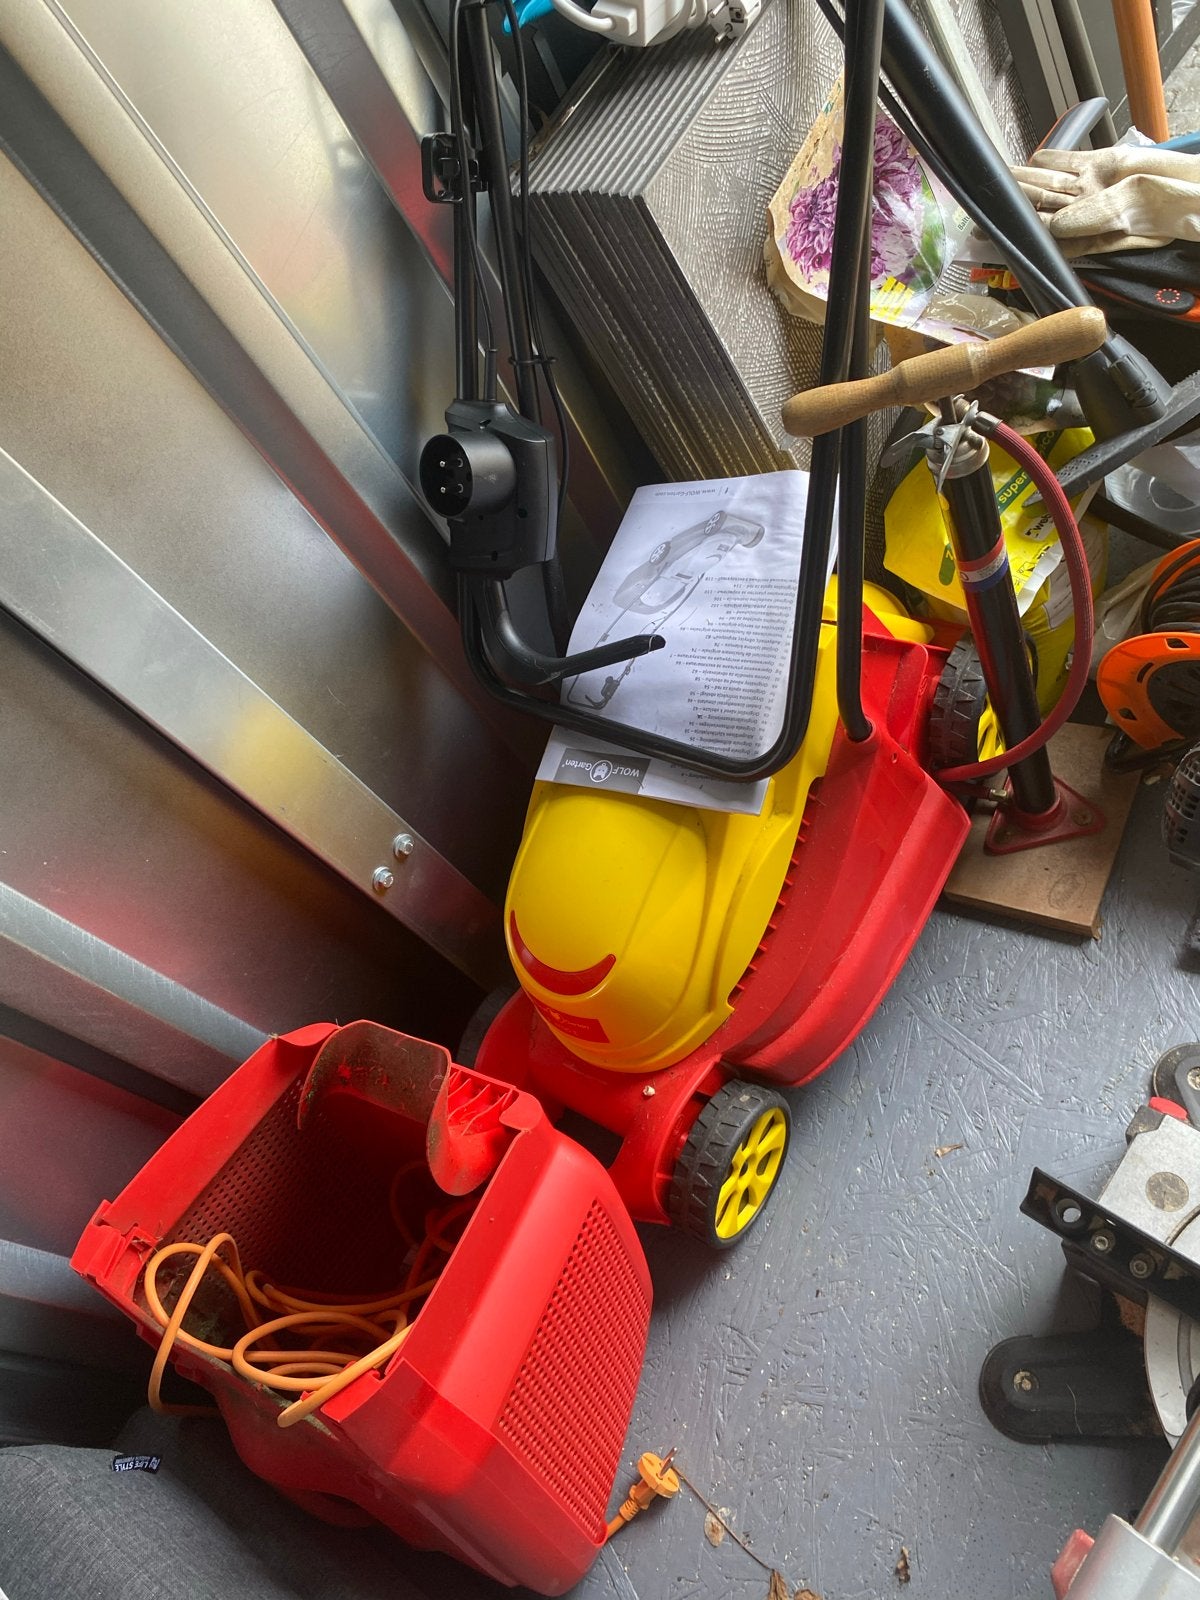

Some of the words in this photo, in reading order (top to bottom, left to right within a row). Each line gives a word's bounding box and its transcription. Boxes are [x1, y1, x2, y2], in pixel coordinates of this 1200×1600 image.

[998, 471, 1028, 504] super
[612, 767, 640, 778] WOLF
[115, 1462, 134, 1472] STYLE
[134, 1460, 149, 1469] LIFE
